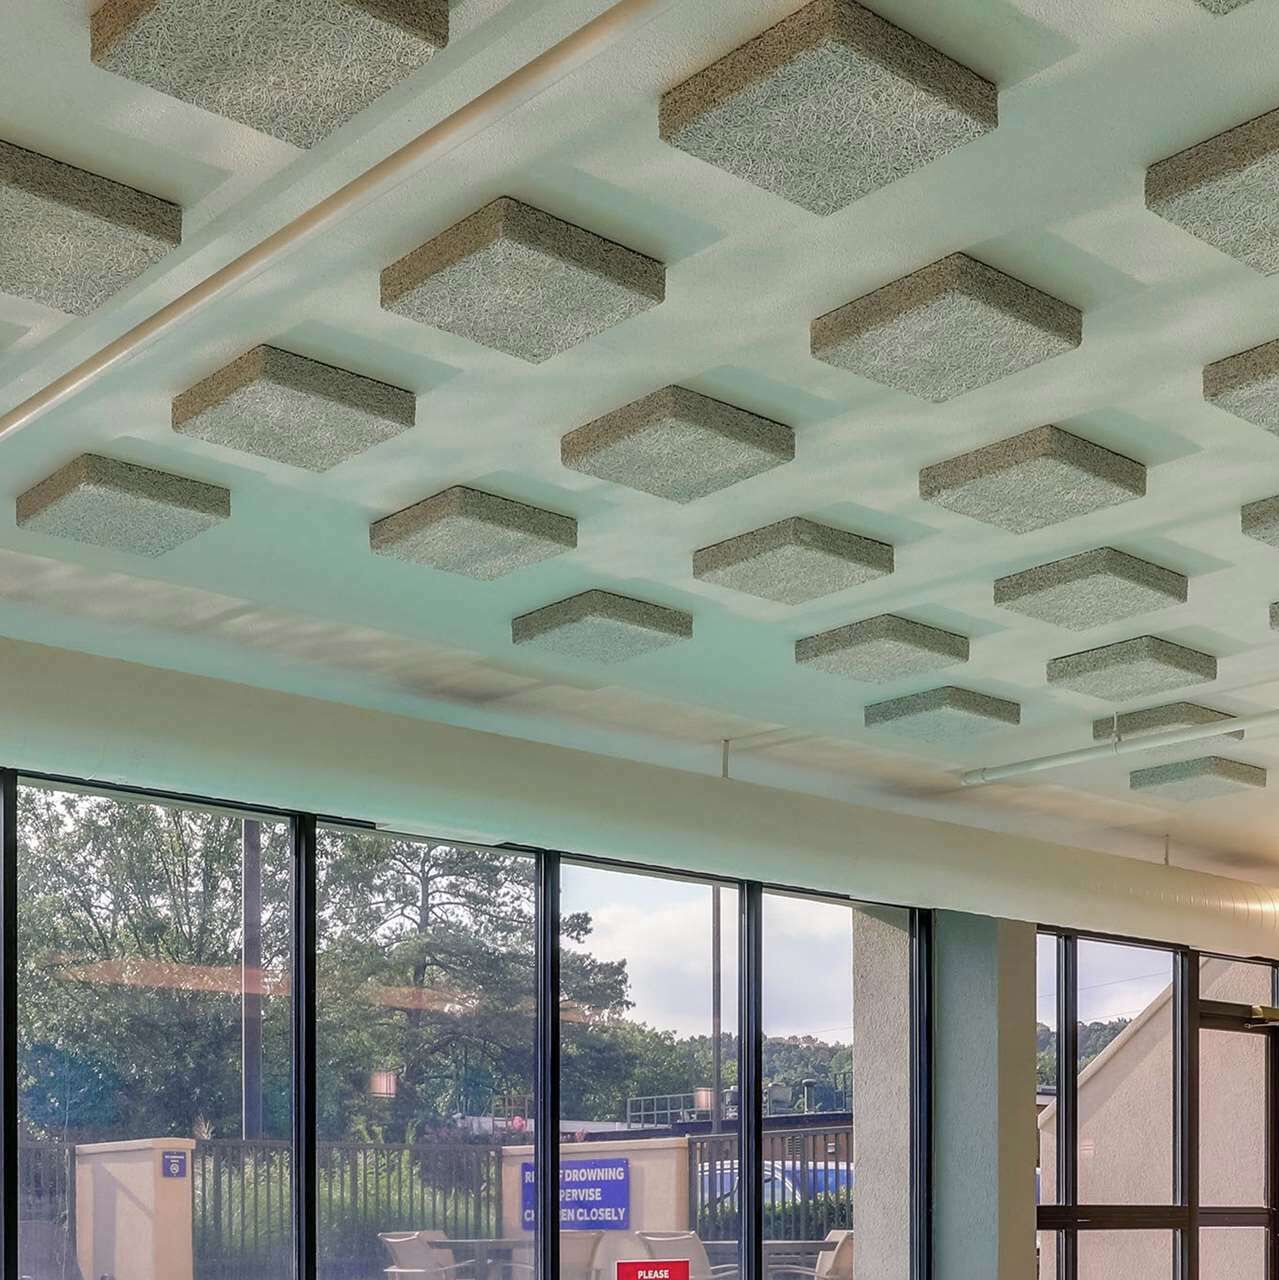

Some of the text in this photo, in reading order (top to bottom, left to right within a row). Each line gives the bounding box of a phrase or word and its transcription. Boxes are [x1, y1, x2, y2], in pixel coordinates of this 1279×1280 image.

[564, 1167, 625, 1181] DROWNING
[560, 1188, 602, 1201] PERVISE
[576, 1208, 626, 1221] CLOSELY
[637, 1269, 669, 1280] PLEASE
